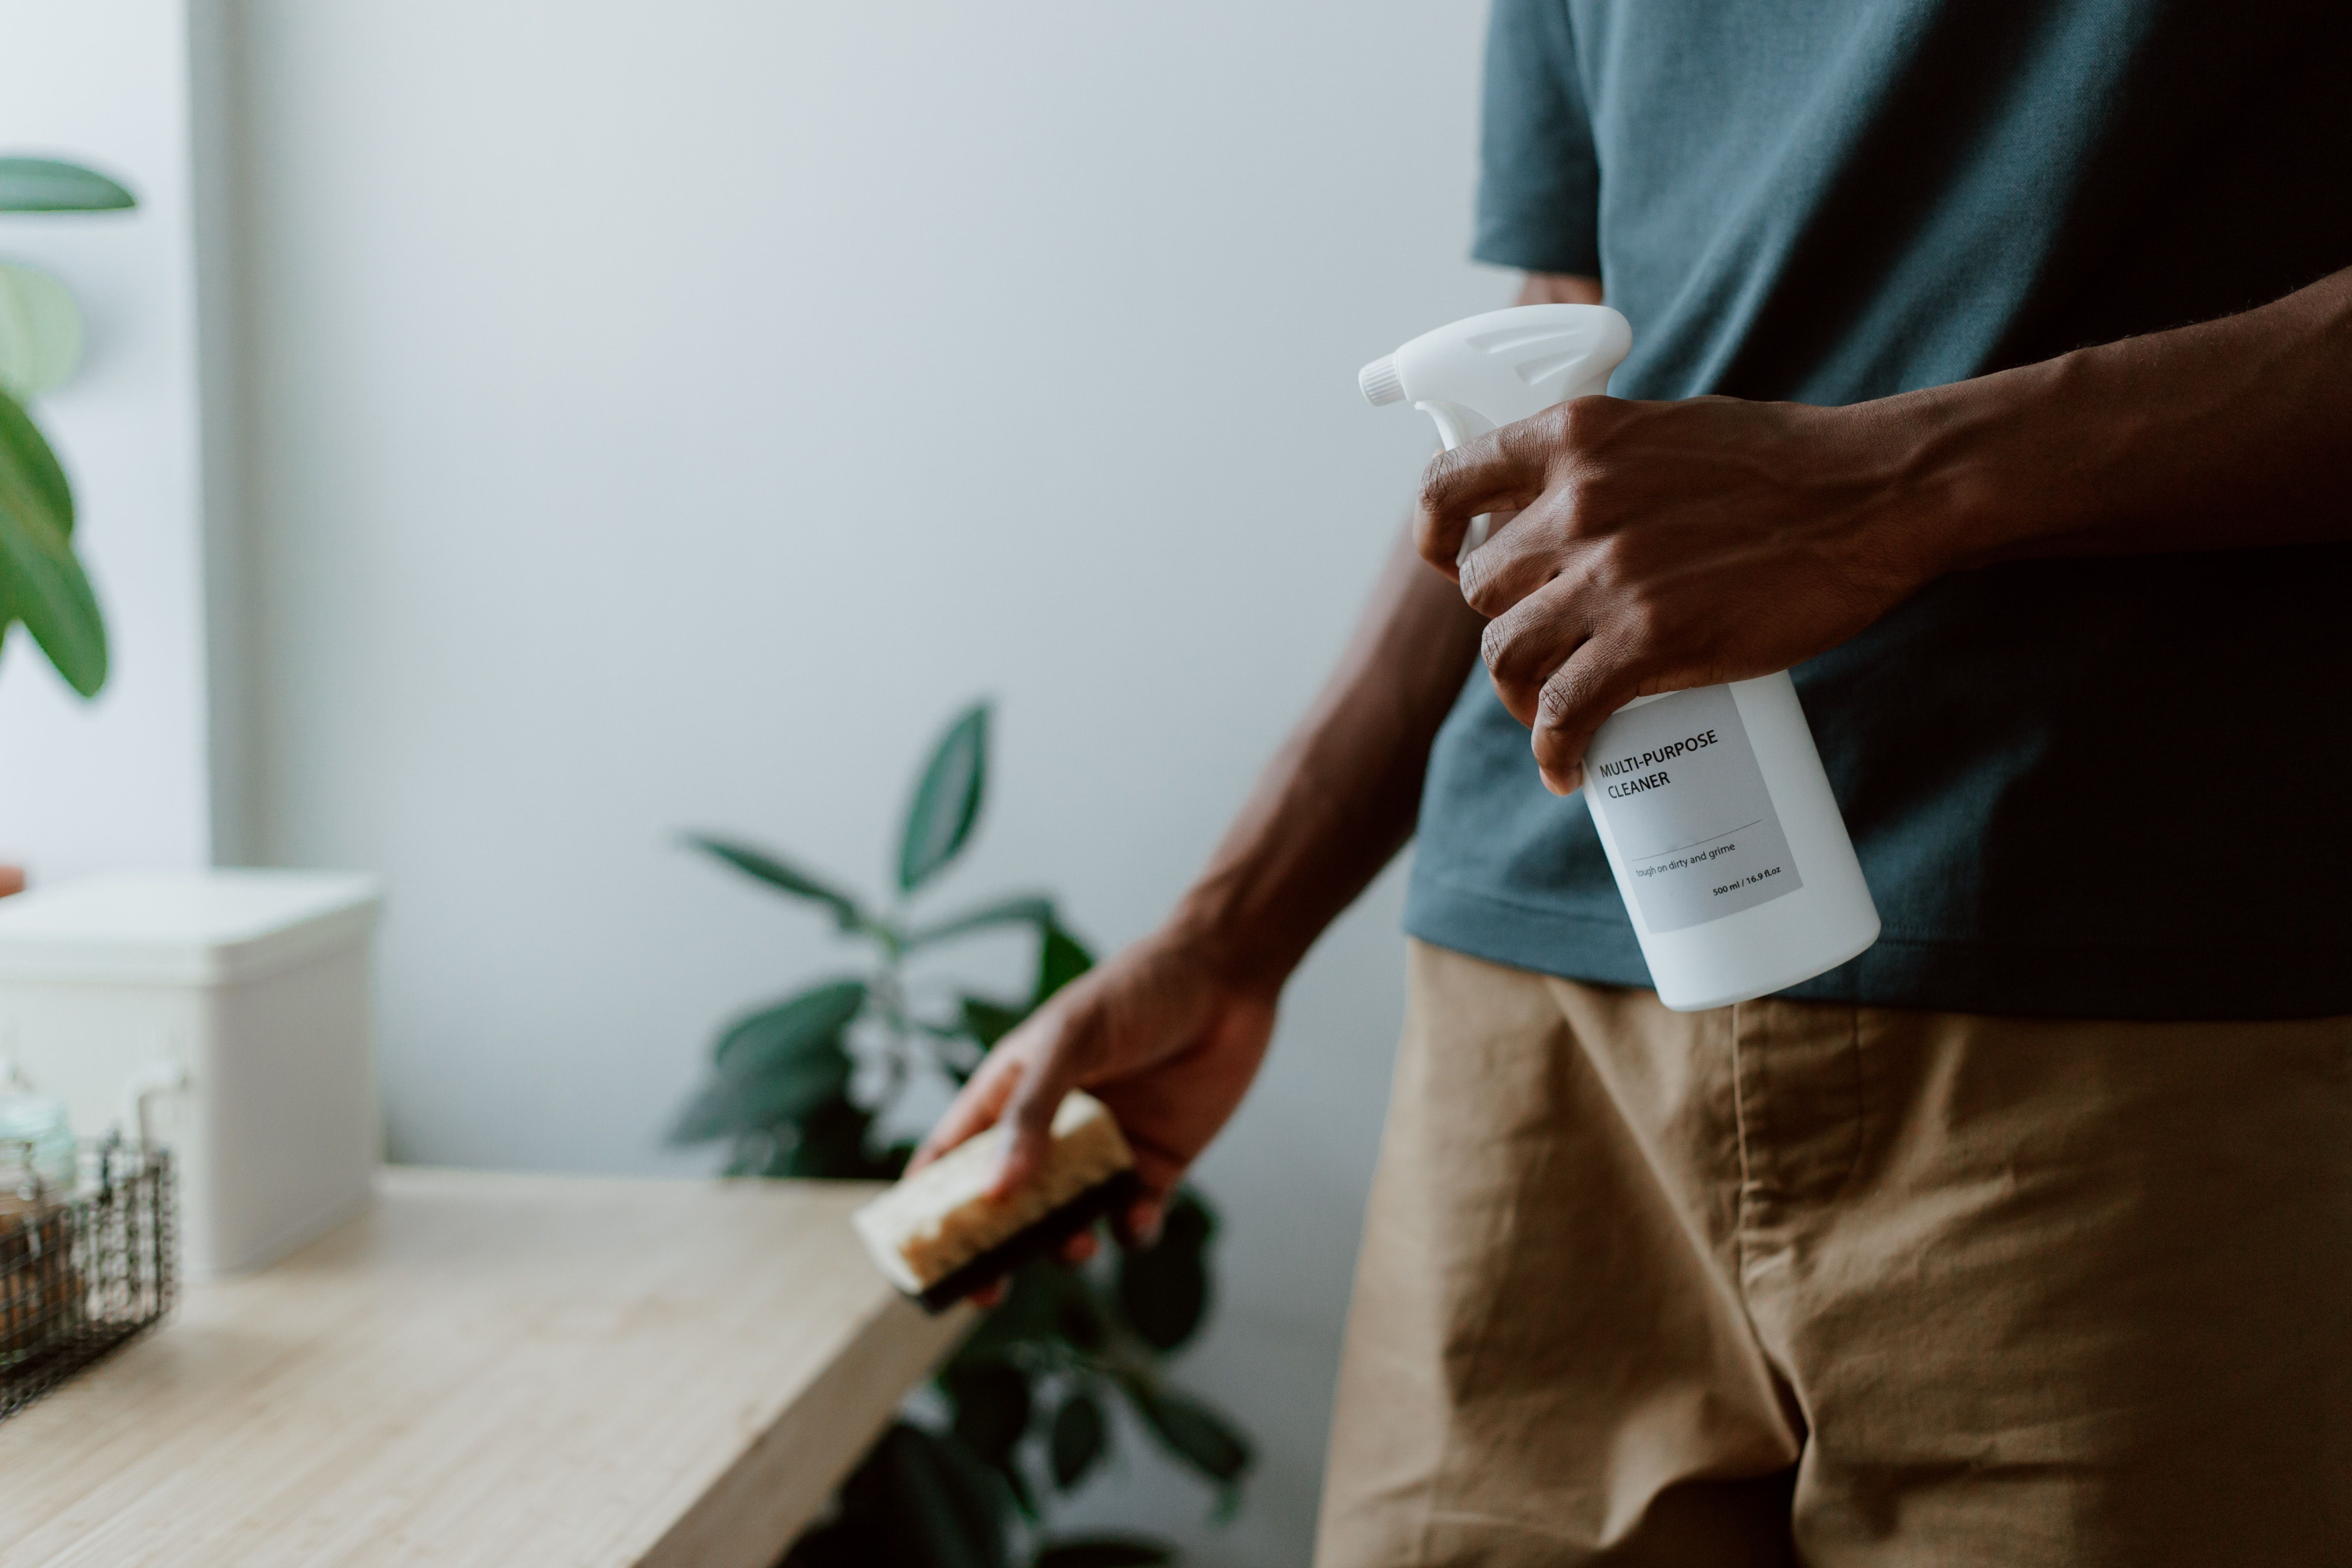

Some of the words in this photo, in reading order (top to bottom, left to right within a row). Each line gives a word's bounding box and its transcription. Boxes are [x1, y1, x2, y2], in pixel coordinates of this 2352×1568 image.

[1599, 729, 1718, 778] MULTI-PURPOSE
[1608, 771, 1671, 799] CLEANER
[1635, 866, 1657, 877] tough
[1657, 865, 1668, 873] on
[1669, 858, 1688, 870] dirty
[1690, 851, 1707, 864] and
[1709, 843, 1736, 860] grime
[1712, 885, 1728, 896] 500
[1729, 880, 1740, 891] ml
[1742, 879, 1745, 888] /
[1746, 873, 1763, 885] 16.9
[1764, 867, 1782, 878] fl.oz
